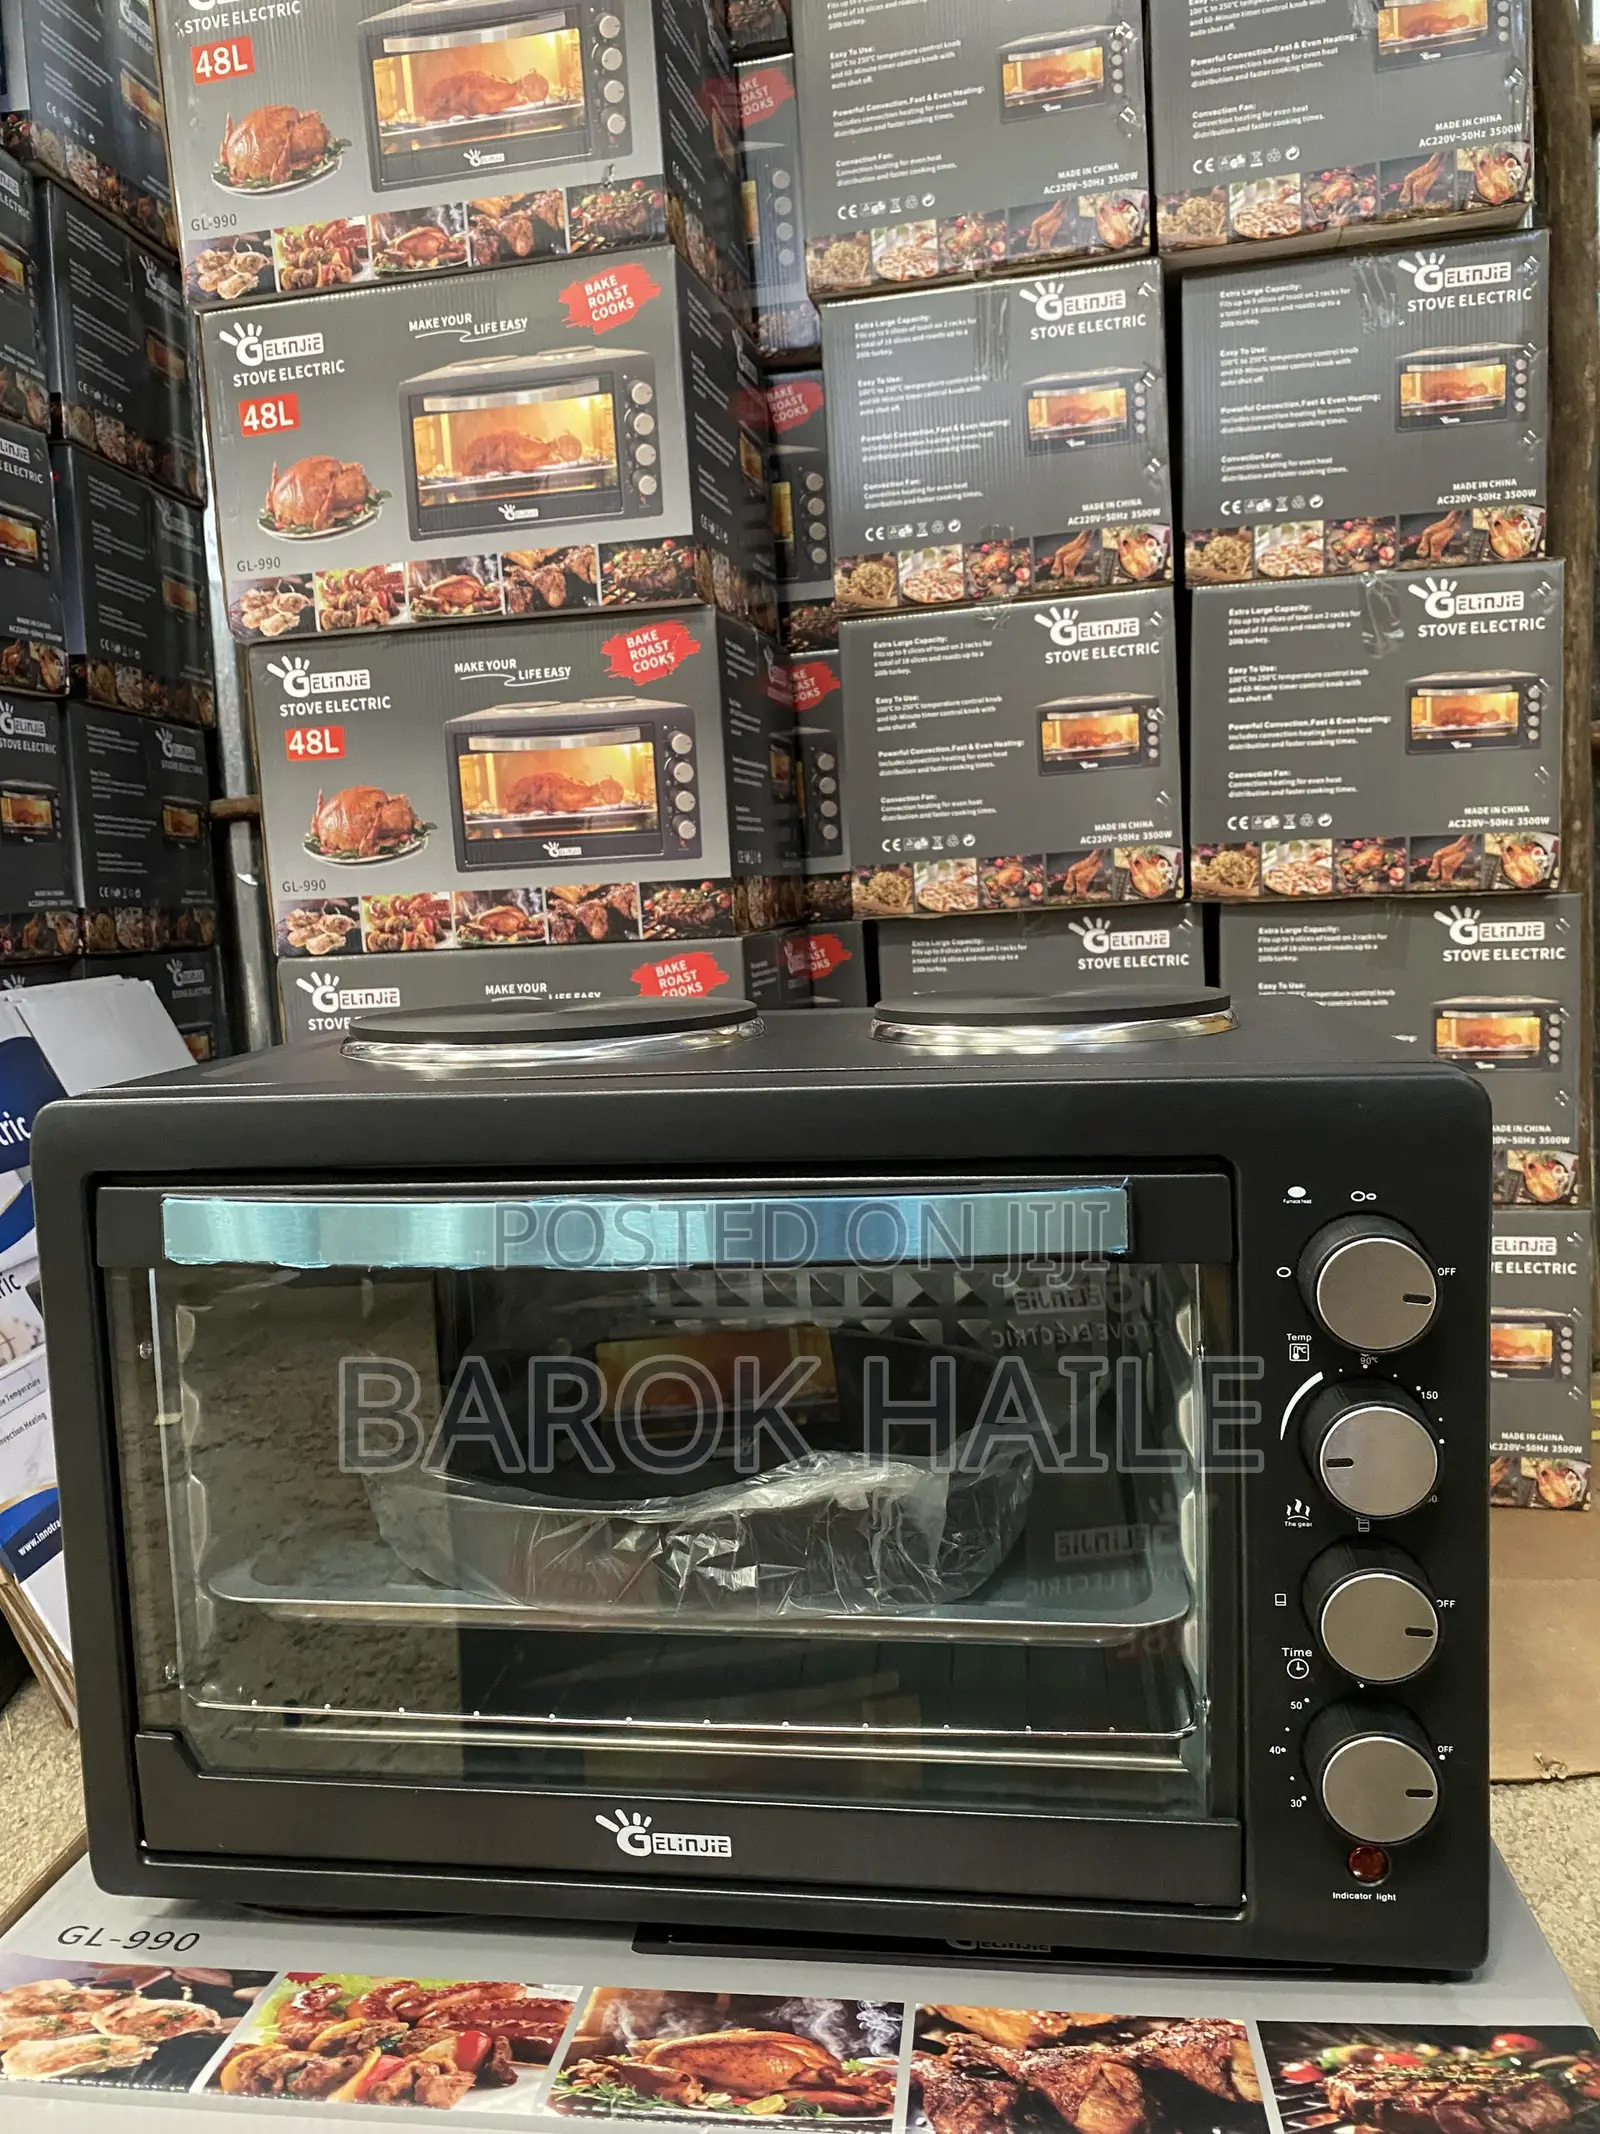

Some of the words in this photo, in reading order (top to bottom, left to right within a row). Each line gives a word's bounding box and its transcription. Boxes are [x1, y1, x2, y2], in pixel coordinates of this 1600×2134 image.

[184, 13, 229, 34] STOVE
[232, 1, 300, 25] ELECTRIC
[1191, 54, 1226, 67] Powerful
[1301, 39, 1321, 48] Even
[196, 44, 248, 78] 48L
[1192, 106, 1237, 119] Convection
[1435, 120, 1460, 131] MADE
[1462, 119, 1471, 127] IN
[1473, 114, 1502, 125] CHINA
[1490, 123, 1522, 136] 3500W
[1058, 169, 1081, 179] MADE
[1093, 162, 1119, 173] CHINA
[1108, 171, 1138, 184] 3500W
[191, 213, 237, 231] GL-990
[584, 274, 618, 295] BAKE
[588, 285, 629, 309] ROAST
[1407, 296, 1455, 312] STOVE
[1459, 288, 1532, 307] ELECTRIC
[591, 297, 635, 322] COOKS
[409, 316, 440, 332] MAKE
[441, 313, 473, 328] YOUR
[474, 322, 498, 336] LIFE
[500, 317, 528, 332] EASY
[1030, 323, 1075, 340] STOVE
[1078, 314, 1146, 334] ELECTRIC
[233, 369, 277, 388] STOVE
[279, 359, 345, 381] ELECTRIC
[244, 400, 294, 431] 48L
[4, 461, 43, 484] ELECTRIC
[1453, 482, 1477, 490] MADE
[1489, 479, 1517, 488] CHINA
[1505, 489, 1536, 499] 3500W
[1082, 502, 1104, 511] MADE
[1116, 498, 1142, 508] CHINA
[1131, 508, 1161, 519] 3500W
[237, 557, 280, 572] GL-990
[1251, 607, 1273, 615] Large
[1418, 622, 1466, 637] STOVE
[1471, 617, 1545, 633] ELECTRIC
[626, 629, 658, 649] BAKE
[629, 640, 670, 662] ROAST
[1045, 648, 1089, 664] STOVE
[1092, 642, 1159, 659] ELECTRIC
[455, 661, 484, 674] MAKE
[486, 658, 517, 671] YOUR
[633, 652, 675, 674] COOKS
[519, 668, 542, 680] LIFE
[544, 665, 571, 678] EASY
[280, 701, 323, 717] STOVE
[326, 696, 391, 713] ELECTRIC
[289, 729, 339, 755] 48L
[1464, 807, 1489, 815] MADE
[1491, 806, 1500, 814] IN
[1502, 805, 1530, 814] CHINA
[1095, 823, 1117, 831] MADE
[1128, 820, 1154, 829] CHINA
[1517, 817, 1550, 825] 3500W
[1143, 830, 1172, 840] 3500W
[282, 878, 326, 892] GL-990
[1078, 956, 1120, 970] STOVE
[1124, 954, 1189, 968] ELECTRIC
[1443, 949, 1490, 962] STOVE
[1494, 947, 1566, 960] ELECTRIC
[656, 960, 687, 977] BAKE
[659, 969, 698, 989] ROAST
[485, 984, 515, 995] MAKE
[517, 983, 547, 994] YOUR
[1539, 1136, 1570, 1144] 3500W
[1437, 1267, 1456, 1276] OFF
[1506, 1261, 1577, 1274] ELECTRIC
[1286, 1333, 1312, 1342] Temp
[1421, 1391, 1438, 1400] 150
[1502, 1432, 1525, 1440] MADE
[1527, 1432, 1535, 1440] IN
[1537, 1432, 1564, 1441] CHINA
[1552, 1445, 1582, 1453] 3500W
[1436, 1599, 1456, 1608] OFF
[1281, 1647, 1313, 1657] Time
[1290, 1701, 1303, 1710] 50
[1269, 1745, 1281, 1755] 40
[1437, 1745, 1454, 1753] OFF
[1290, 1799, 1302, 1808] 30
[1332, 1891, 1372, 1900] Indicator
[1376, 1892, 1396, 1902] light
[57, 1925, 200, 1952] GL-990
